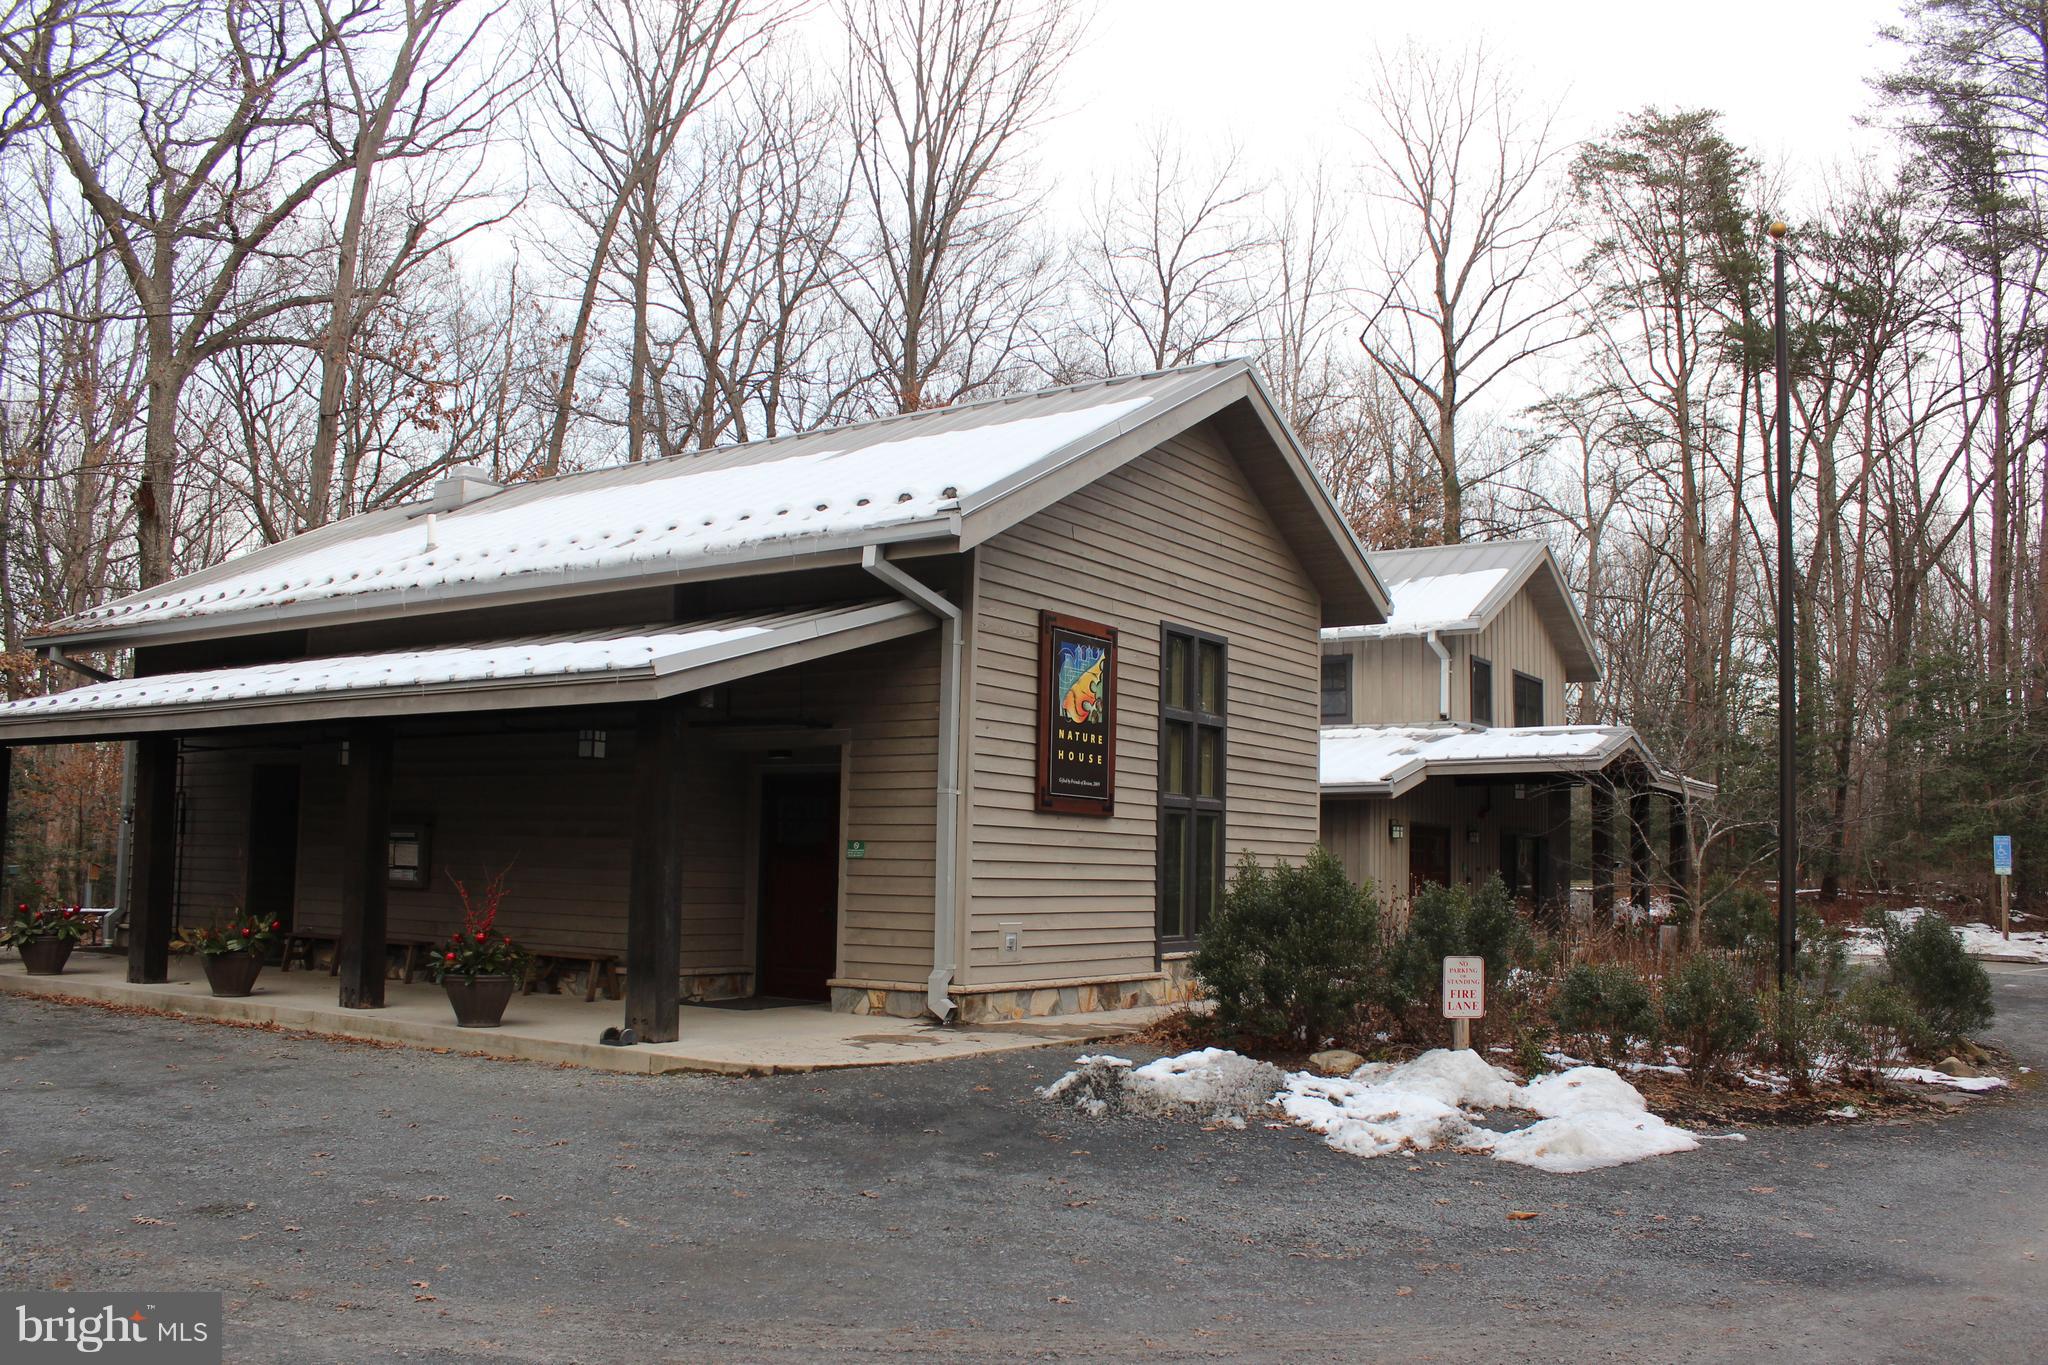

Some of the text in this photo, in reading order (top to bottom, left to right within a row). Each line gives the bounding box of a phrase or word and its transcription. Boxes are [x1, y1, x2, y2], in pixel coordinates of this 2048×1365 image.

[1058, 729, 1103, 745] NATURE
[1058, 749, 1102, 765] HOUSE
[1450, 989, 1477, 998] FIRE
[1448, 1001, 1479, 1010] LANE
